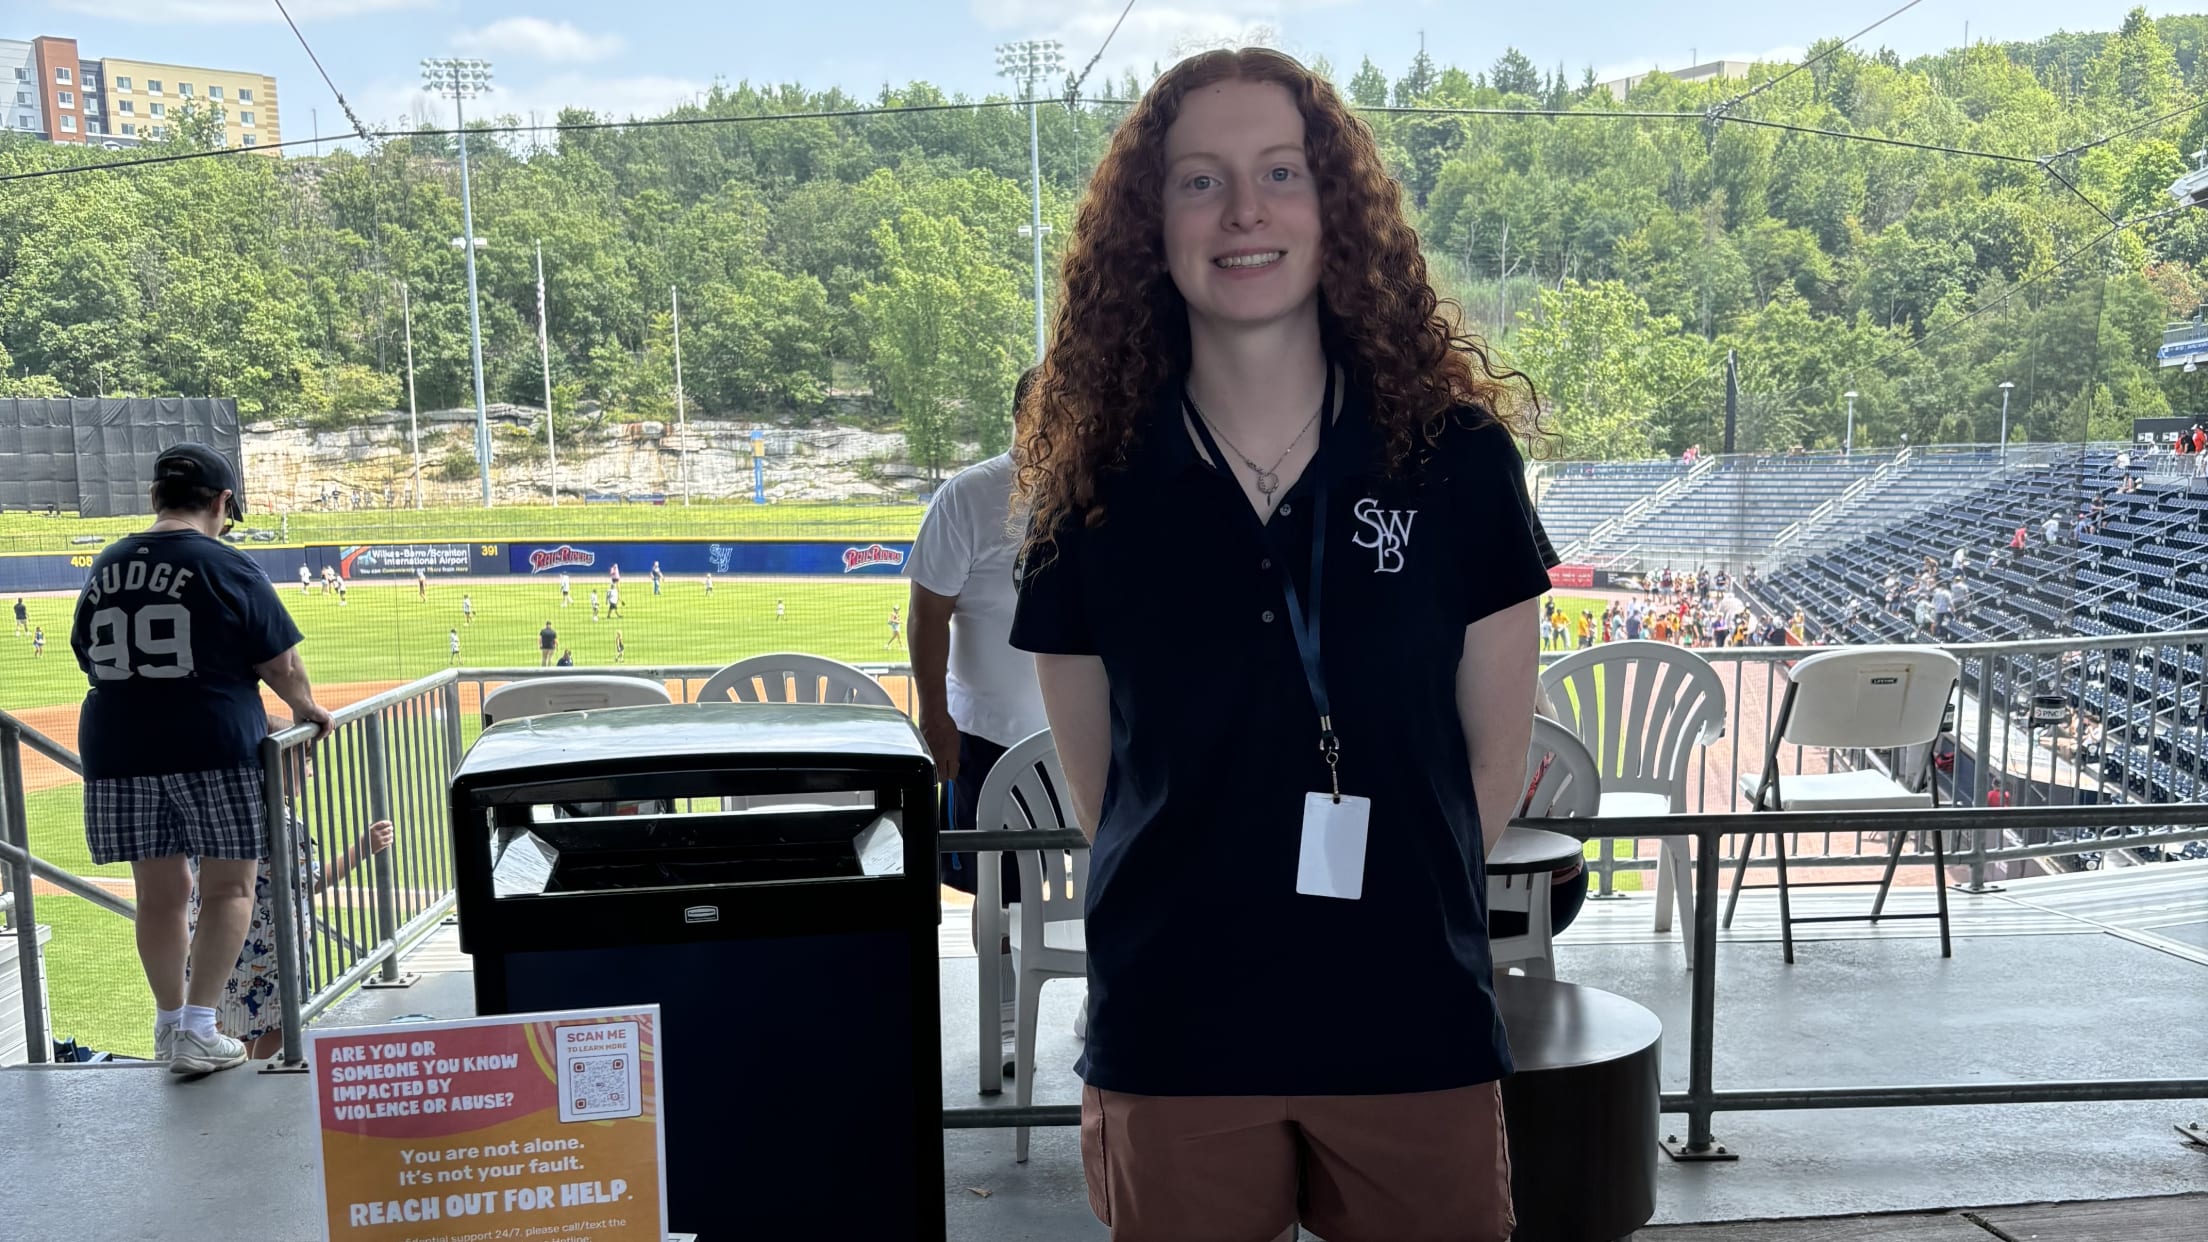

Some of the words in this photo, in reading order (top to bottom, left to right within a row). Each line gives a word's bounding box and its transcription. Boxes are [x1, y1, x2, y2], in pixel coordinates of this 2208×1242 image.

[71, 556, 93, 567] 408
[372, 548, 467, 558] Wilkes-Barre/Scranton
[384, 557, 436, 565] International
[439, 556, 468, 565] Airport
[481, 545, 498, 556] 391
[88, 560, 194, 606] JUDGE
[88, 603, 195, 681] 99
[567, 1031, 604, 1043] SCAN
[607, 1029, 627, 1040] ME
[579, 1044, 604, 1052] LEARN
[605, 1042, 627, 1050] MORE
[331, 1045, 366, 1063] ARE
[369, 1042, 408, 1060] YOU
[411, 1040, 436, 1057] OR
[331, 1061, 419, 1083] SOMEONE
[423, 1058, 460, 1075] YOU
[464, 1053, 519, 1072] KNOW
[333, 1080, 424, 1102] IMPACTED
[427, 1078, 453, 1095] BY
[334, 1102, 420, 1121] VIOLENCE
[423, 1098, 447, 1114] OR
[450, 1092, 515, 1112] ABUSE?
[401, 1149, 441, 1165] You
[445, 1148, 480, 1161] are
[483, 1140, 519, 1158] not
[523, 1137, 585, 1155] alone.
[400, 1170, 433, 1186] It's
[438, 1165, 473, 1183] not
[477, 1164, 525, 1183] your
[528, 1155, 585, 1175] fault.
[350, 1196, 440, 1228] REACH
[445, 1191, 498, 1218] OUT
[503, 1185, 556, 1213] FOR
[560, 1178, 634, 1208] HELP.
[450, 1231, 492, 1242] support
[525, 1225, 560, 1237] please
[562, 1219, 607, 1231] call/text
[608, 1218, 627, 1227] the
